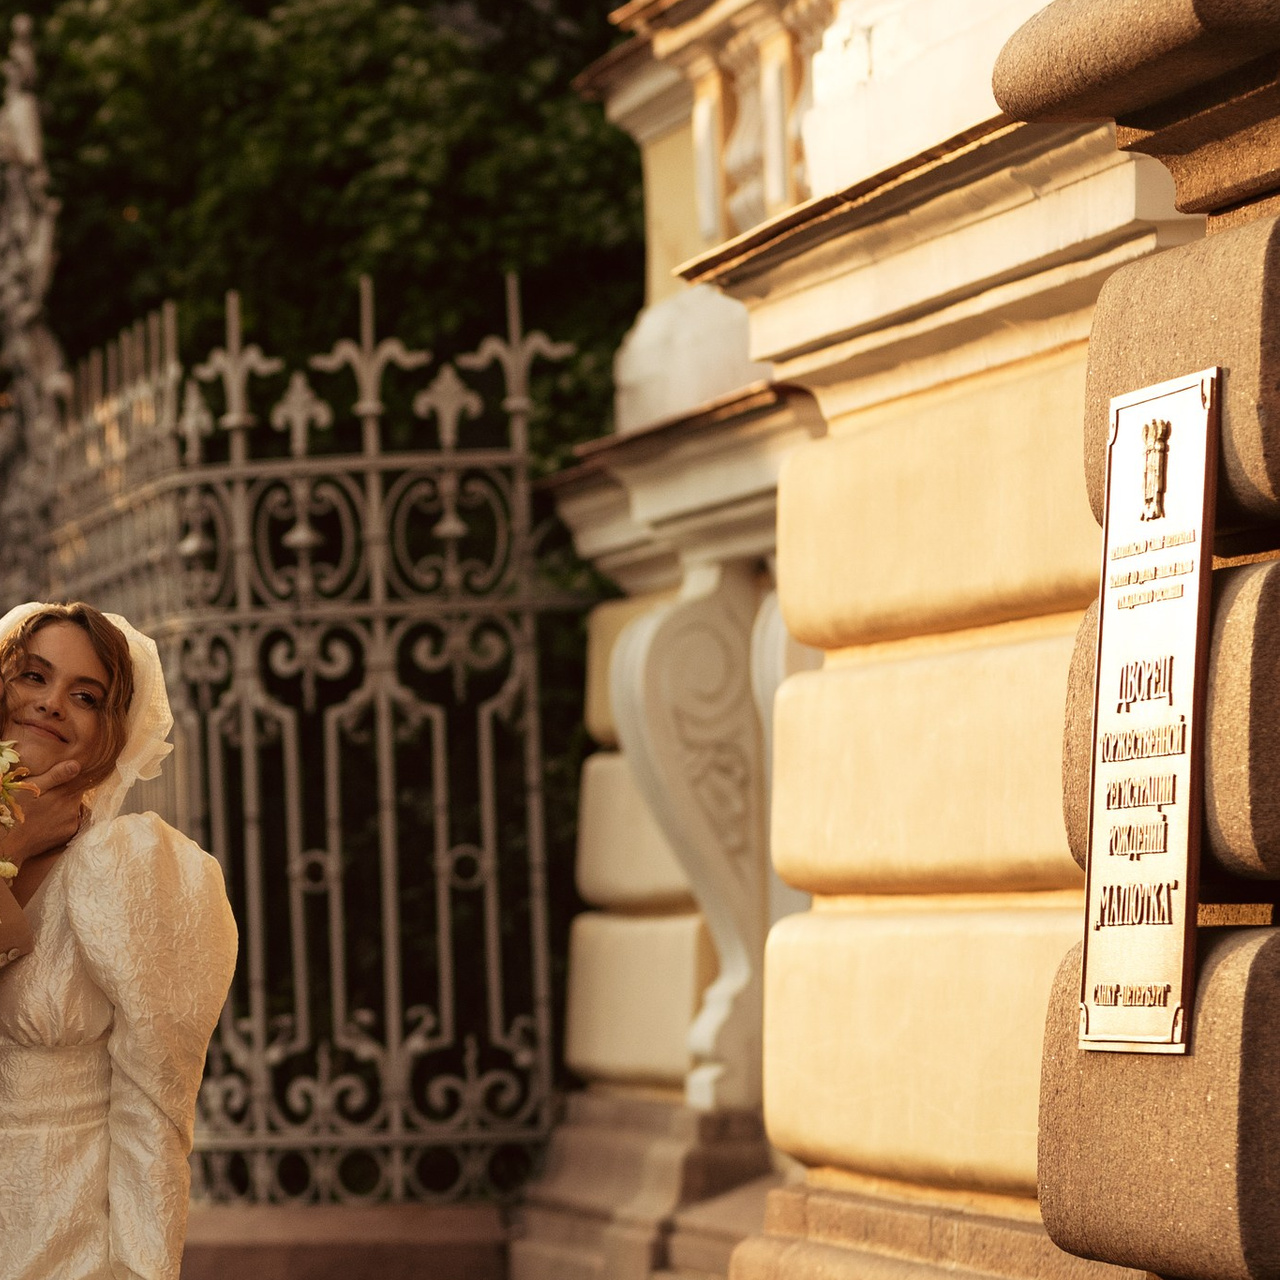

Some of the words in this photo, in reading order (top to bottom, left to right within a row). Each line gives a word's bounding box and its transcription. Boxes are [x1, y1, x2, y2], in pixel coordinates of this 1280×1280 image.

[1117, 655, 1174, 713] ДВОРЕЦ
[1099, 715, 1186, 763] ТОРЖЕСТВЕННОЙ
[1106, 774, 1177, 812] РЕГИСТРАЦИИ
[1109, 815, 1169, 861] РОЖДЕНИЙ
